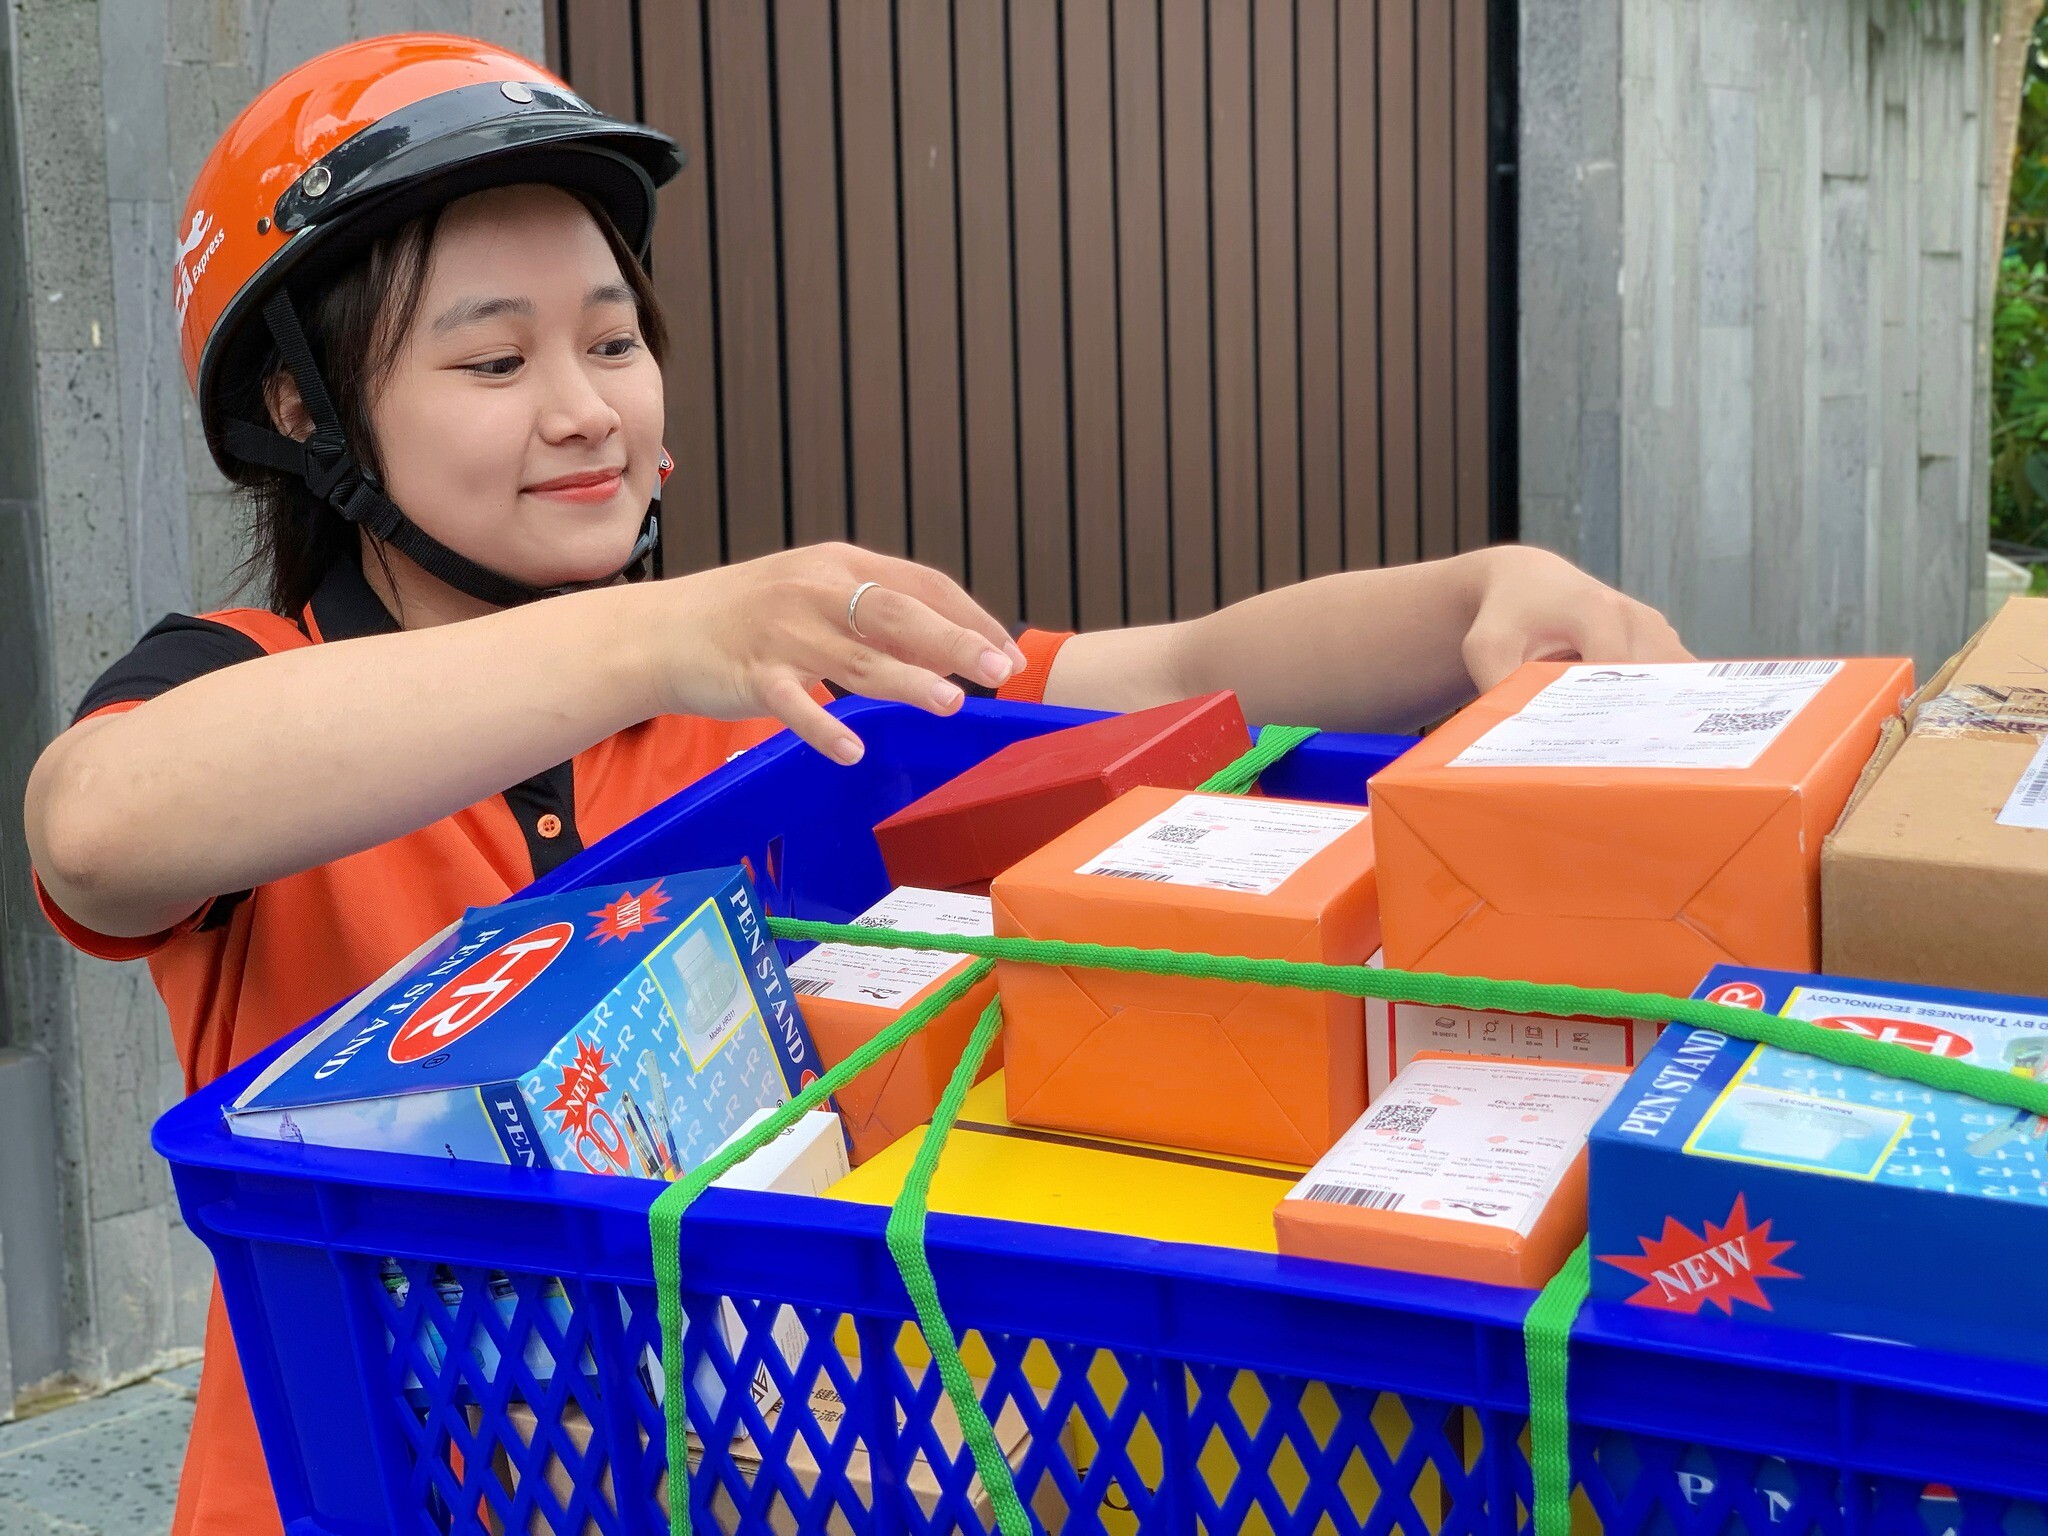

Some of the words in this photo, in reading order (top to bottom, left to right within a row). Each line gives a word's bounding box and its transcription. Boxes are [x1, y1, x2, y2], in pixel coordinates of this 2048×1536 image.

[192, 228, 225, 285] Express
[616, 898, 641, 930] NEW
[427, 927, 505, 977] PEN
[729, 885, 766, 956] PEN
[756, 956, 805, 1065] STAND
[403, 936, 562, 1041] HR
[1806, 994, 1912, 1014] TECHNOLOGY
[314, 982, 434, 1080] STAND
[709, 1010, 737, 1042] Model_HR311
[2013, 1018, 2037, 1030] BY
[566, 1056, 598, 1117] NEW
[1618, 1092, 1682, 1138] PEN
[1652, 1030, 1728, 1093] STAND
[1650, 1235, 1751, 1302] NEW
